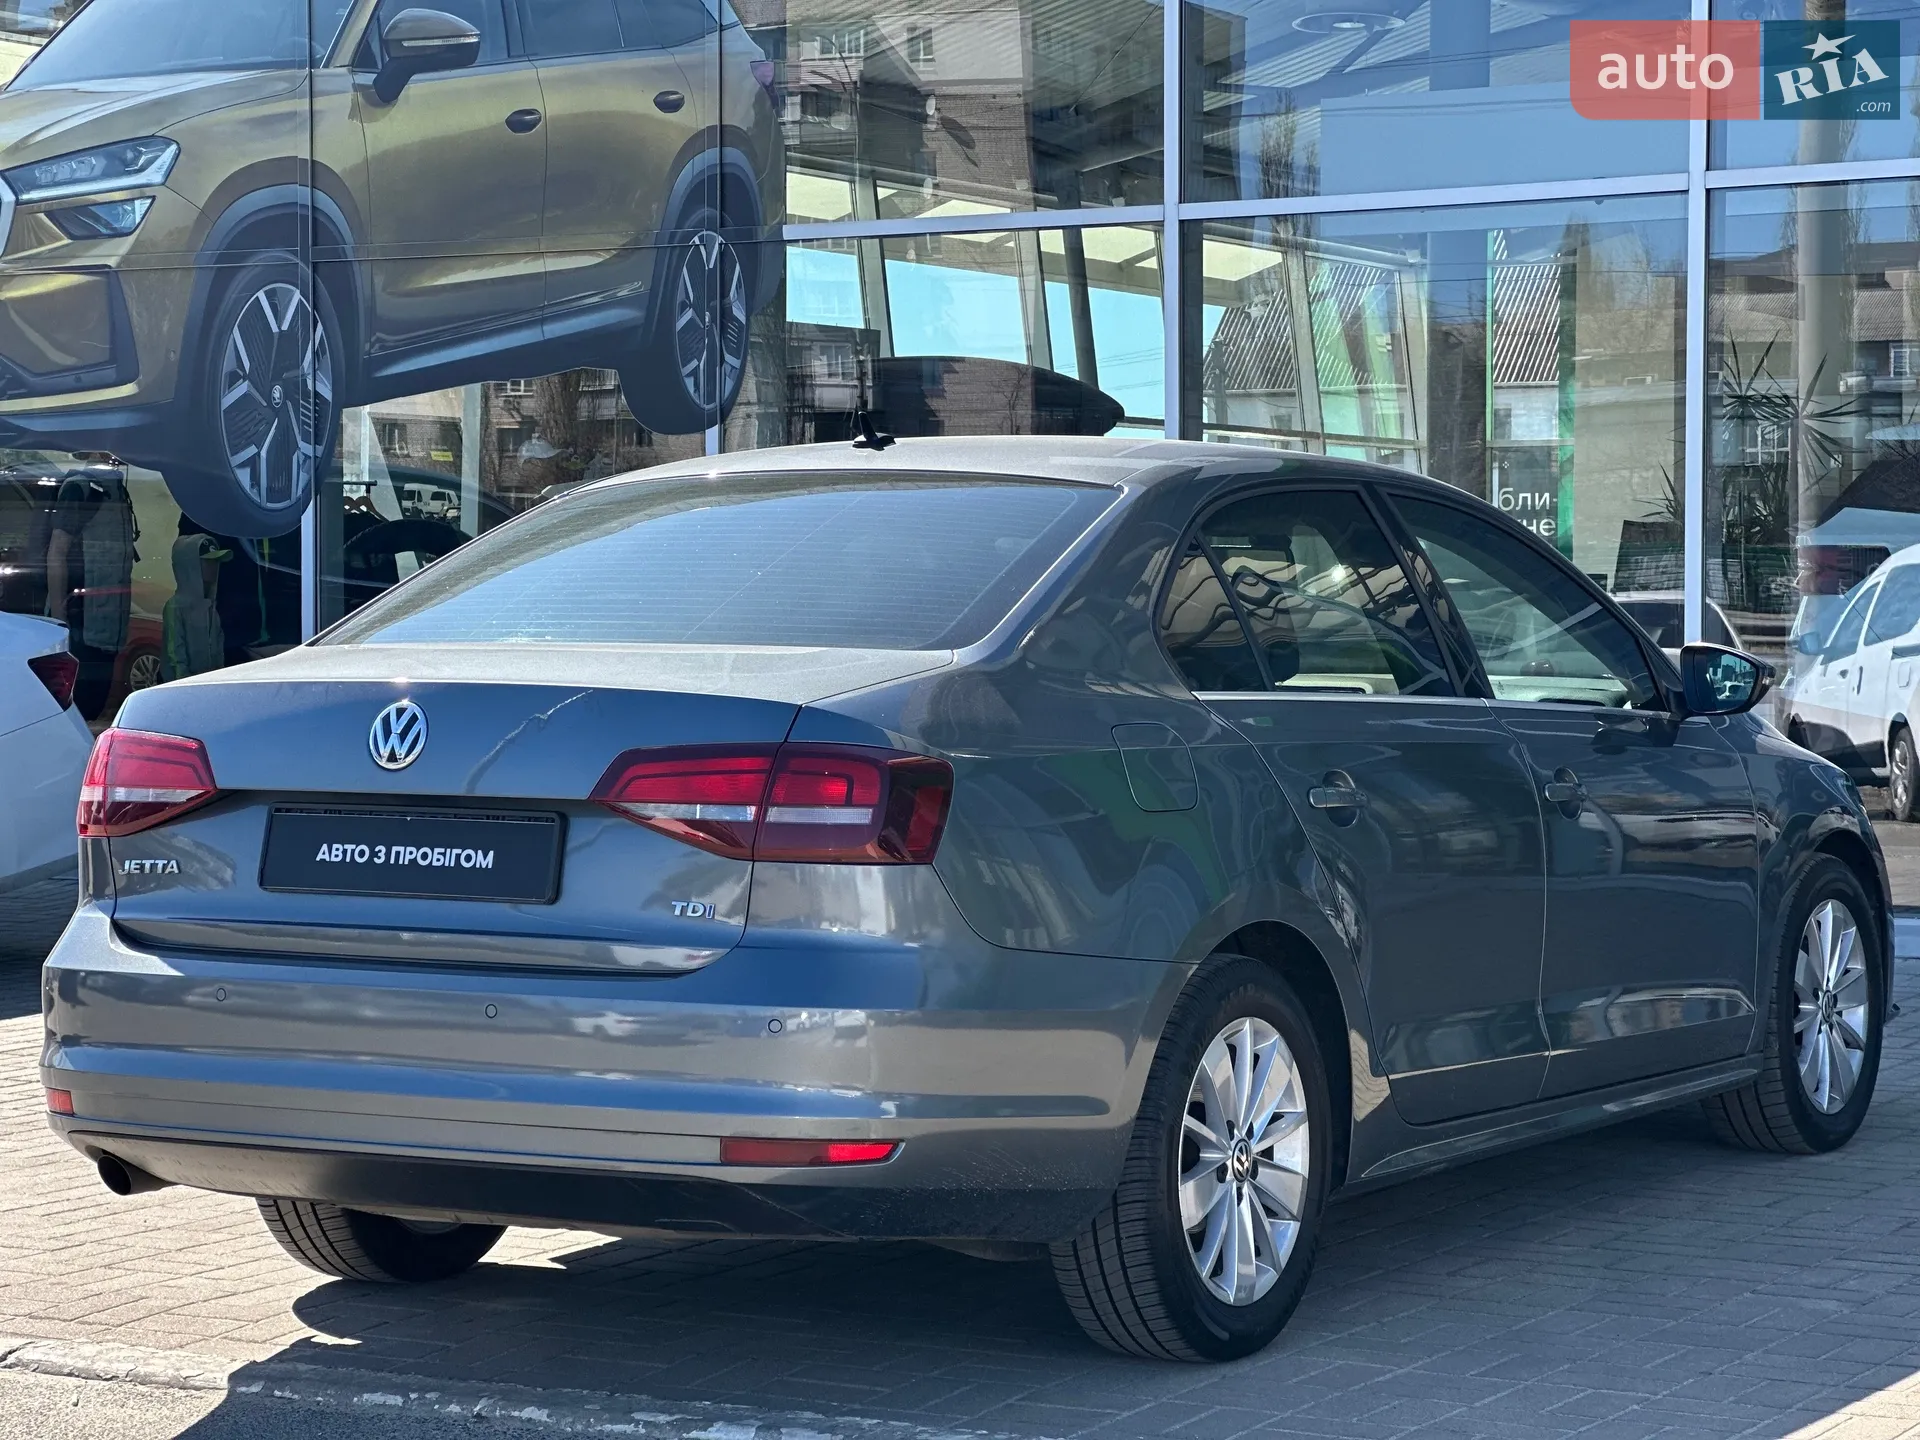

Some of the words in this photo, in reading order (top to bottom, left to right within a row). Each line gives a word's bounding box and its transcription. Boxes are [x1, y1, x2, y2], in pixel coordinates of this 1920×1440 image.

[1498, 487, 1558, 511] бли-
[1517, 518, 1556, 537] не
[315, 843, 370, 864] АВТО
[389, 846, 494, 869] ПРОБІГОМ
[118, 859, 180, 875] JETTA
[671, 900, 716, 919] TDI
